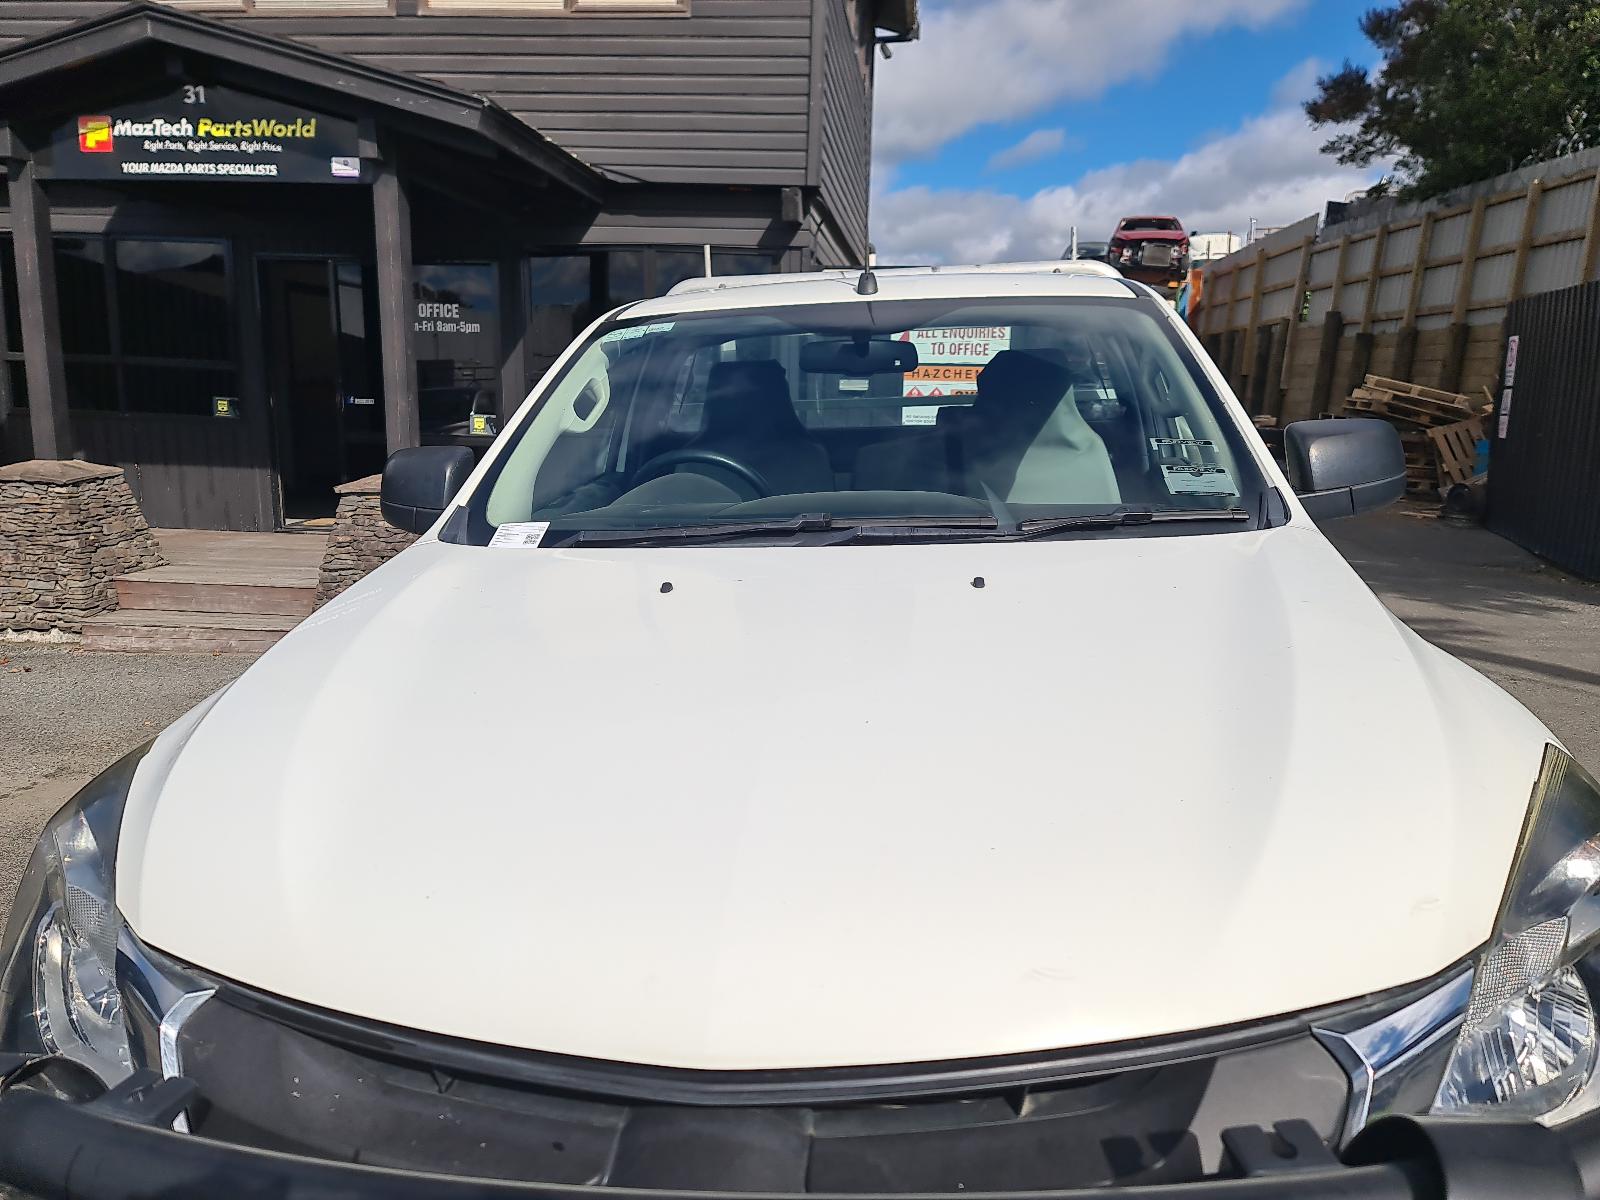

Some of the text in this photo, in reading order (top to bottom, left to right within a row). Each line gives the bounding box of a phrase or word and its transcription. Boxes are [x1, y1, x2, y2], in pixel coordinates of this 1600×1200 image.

[183, 84, 207, 104] 31
[112, 117, 316, 138] MazTech PartsWorld
[121, 162, 278, 176] YOUR MAZDA PARTS SPECIALISTS
[419, 304, 459, 318] OFFICE
[437, 321, 480, 333] 8am-5pm
[917, 327, 1005, 340] ALL ENQUIRIES
[931, 342, 989, 356] TO OFFICE
